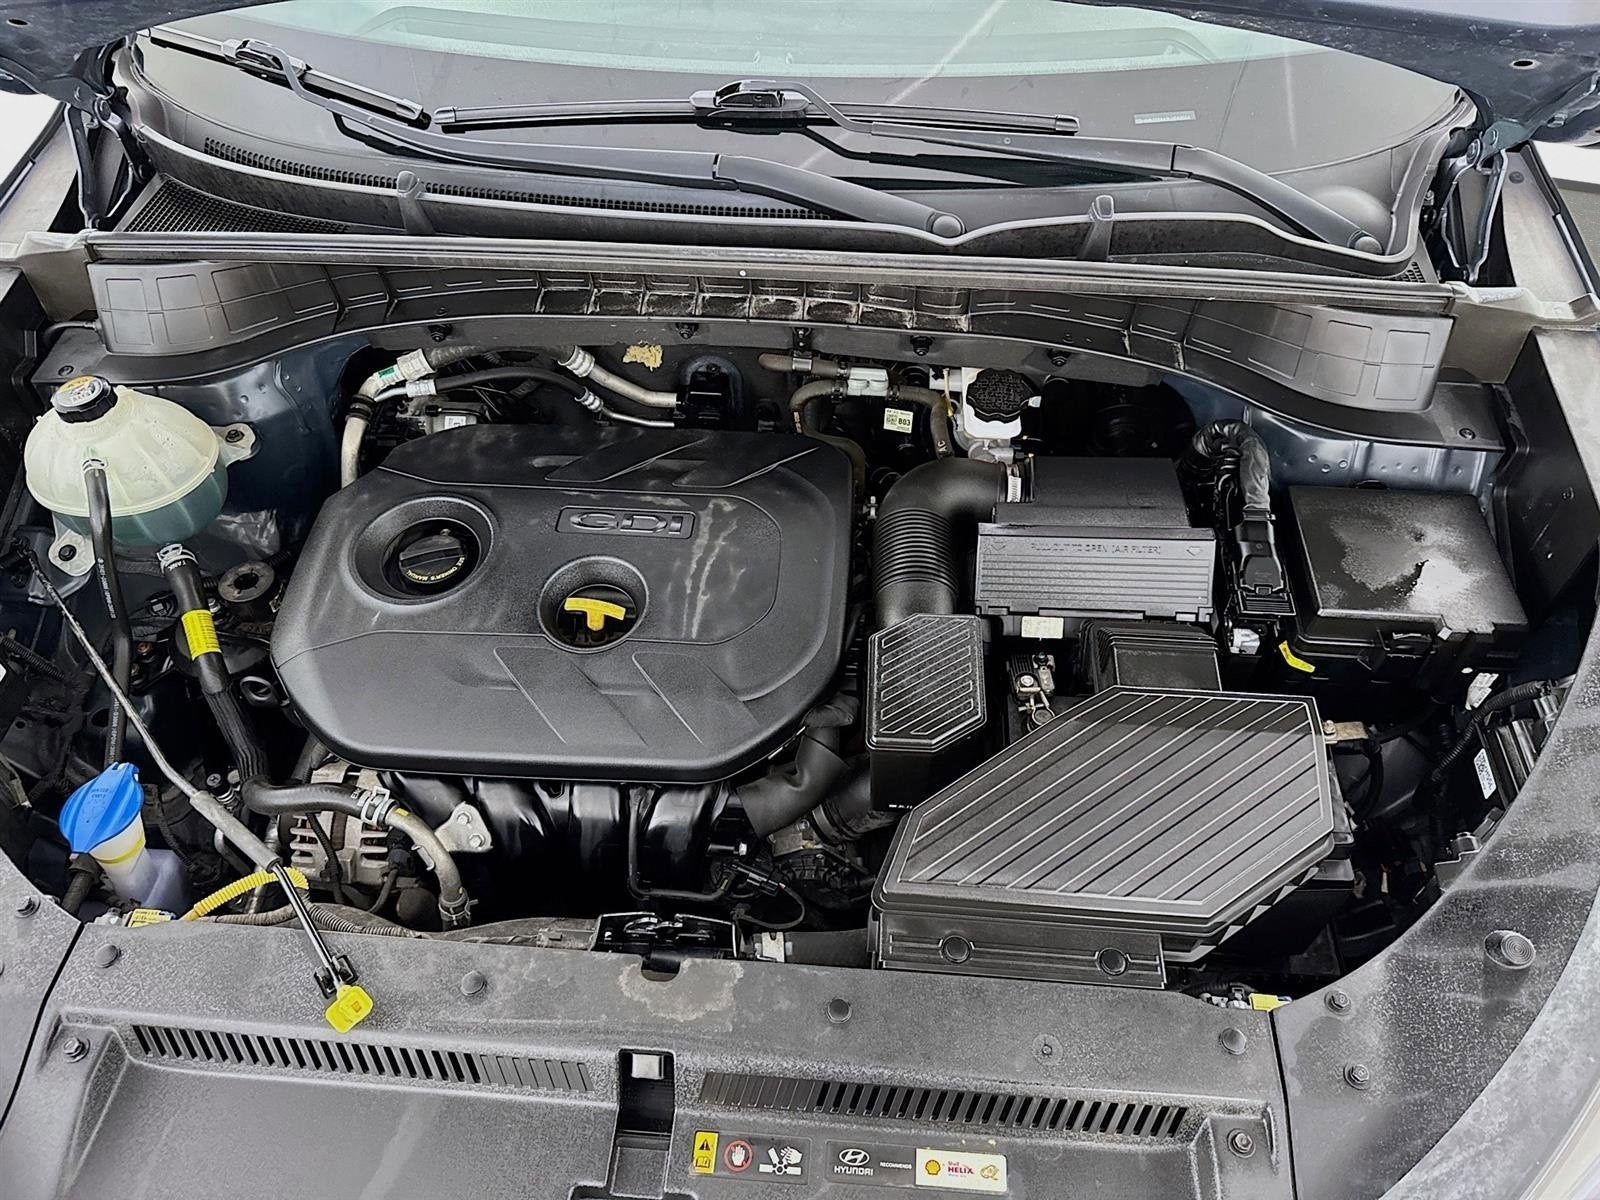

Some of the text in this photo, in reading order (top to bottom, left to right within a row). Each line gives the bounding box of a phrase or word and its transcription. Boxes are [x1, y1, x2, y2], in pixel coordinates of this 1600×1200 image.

[937, 440, 947, 453] AC
[569, 511, 682, 536] GDI
[1084, 543, 1108, 553] OPEN
[834, 1161, 913, 1177] HYUNDAI RECOMMENDS
[947, 1166, 975, 1175] HELIX
